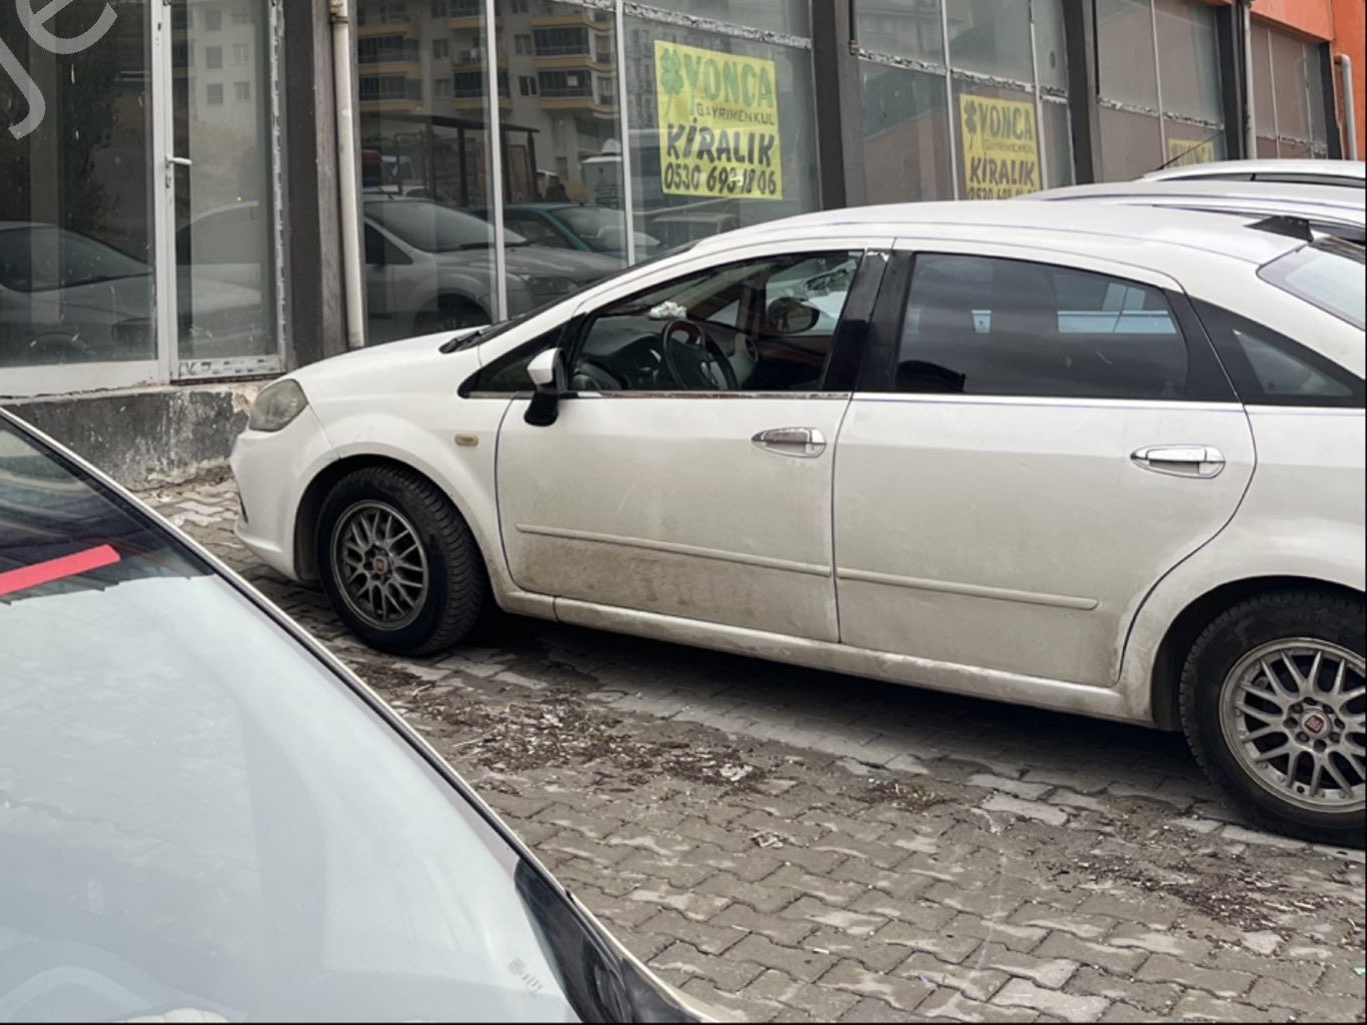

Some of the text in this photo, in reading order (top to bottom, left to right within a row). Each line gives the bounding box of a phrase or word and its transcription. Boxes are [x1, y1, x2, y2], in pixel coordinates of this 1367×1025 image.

[683, 53, 774, 115] YONCA
[696, 102, 775, 126] GAYRIMENKUL
[667, 117, 775, 167] KİRALIK
[664, 162, 701, 191] 0530
[758, 170, 776, 195] 06
